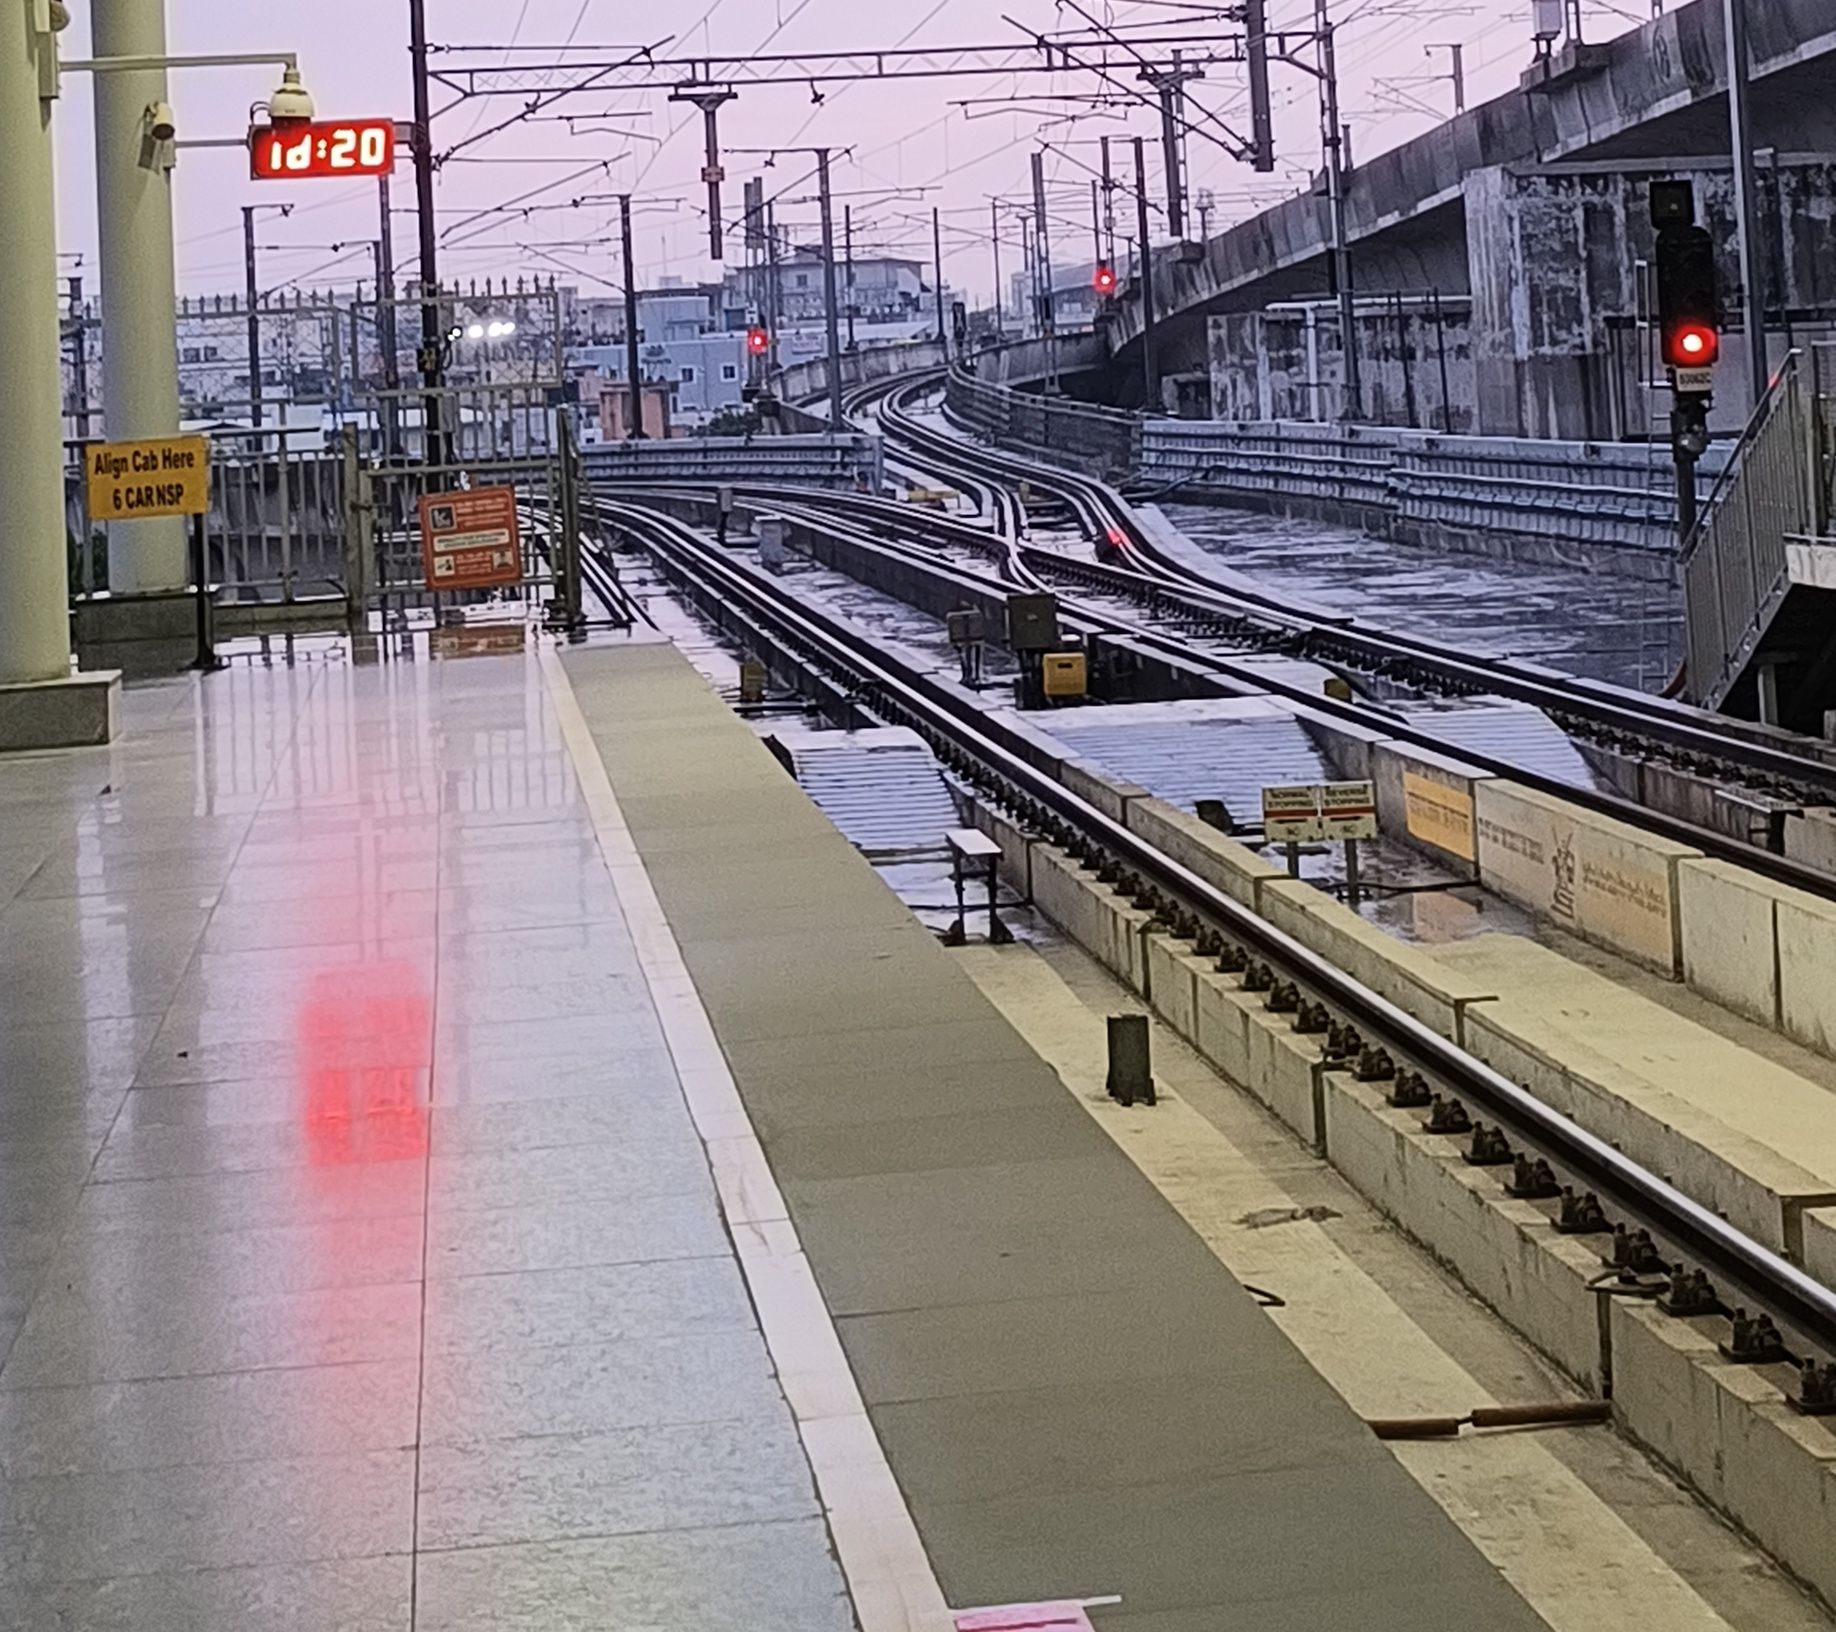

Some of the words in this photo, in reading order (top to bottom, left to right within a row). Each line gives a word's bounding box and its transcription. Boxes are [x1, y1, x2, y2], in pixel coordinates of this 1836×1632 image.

[94, 452, 129, 480] Align
[132, 450, 159, 473] Cab
[162, 448, 195, 470] Here
[113, 489, 122, 510] 6
[125, 486, 155, 509] CAR
[156, 483, 184, 506] NSP
